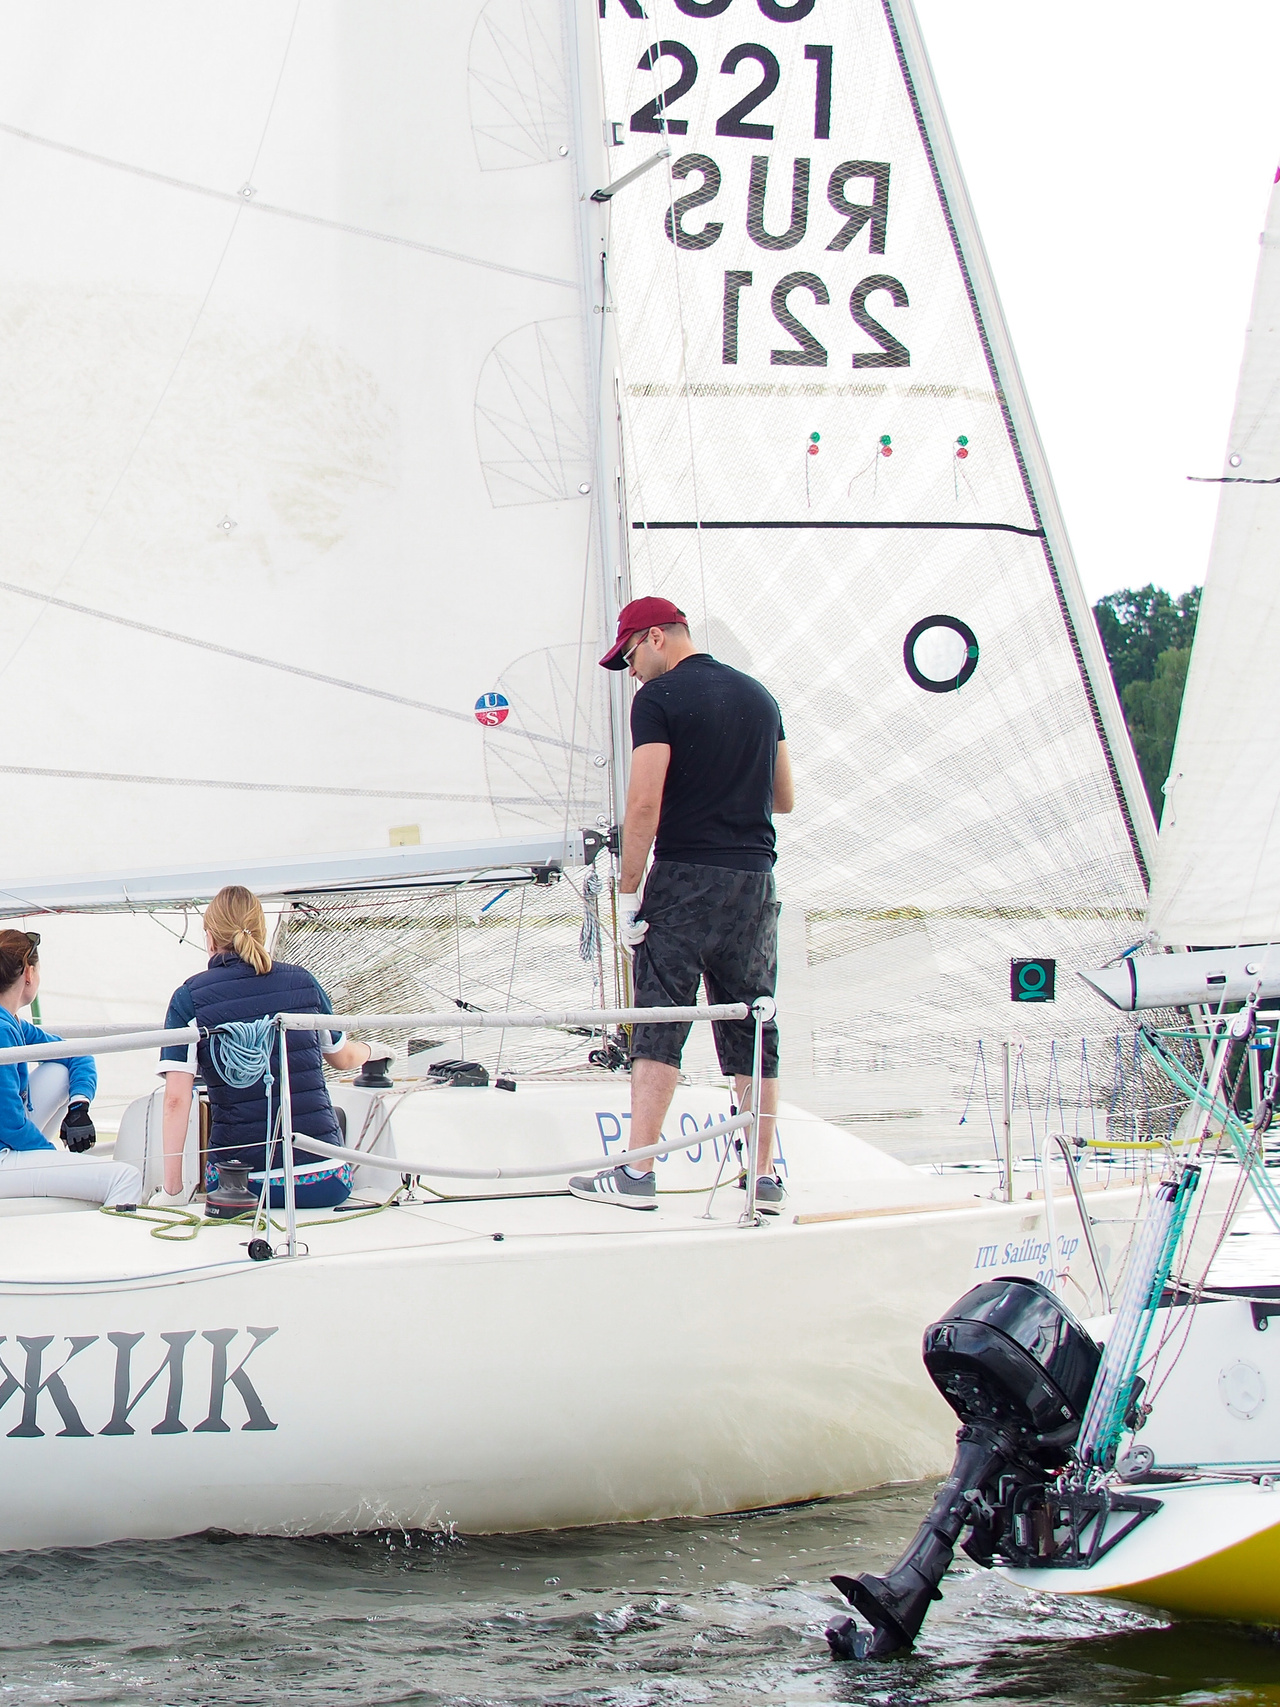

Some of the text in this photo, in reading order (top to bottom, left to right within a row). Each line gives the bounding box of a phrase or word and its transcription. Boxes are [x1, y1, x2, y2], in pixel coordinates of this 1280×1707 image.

[630, 40, 833, 140] 221
[974, 1245, 998, 1268] ITL
[1002, 1238, 1050, 1265] Sailing
